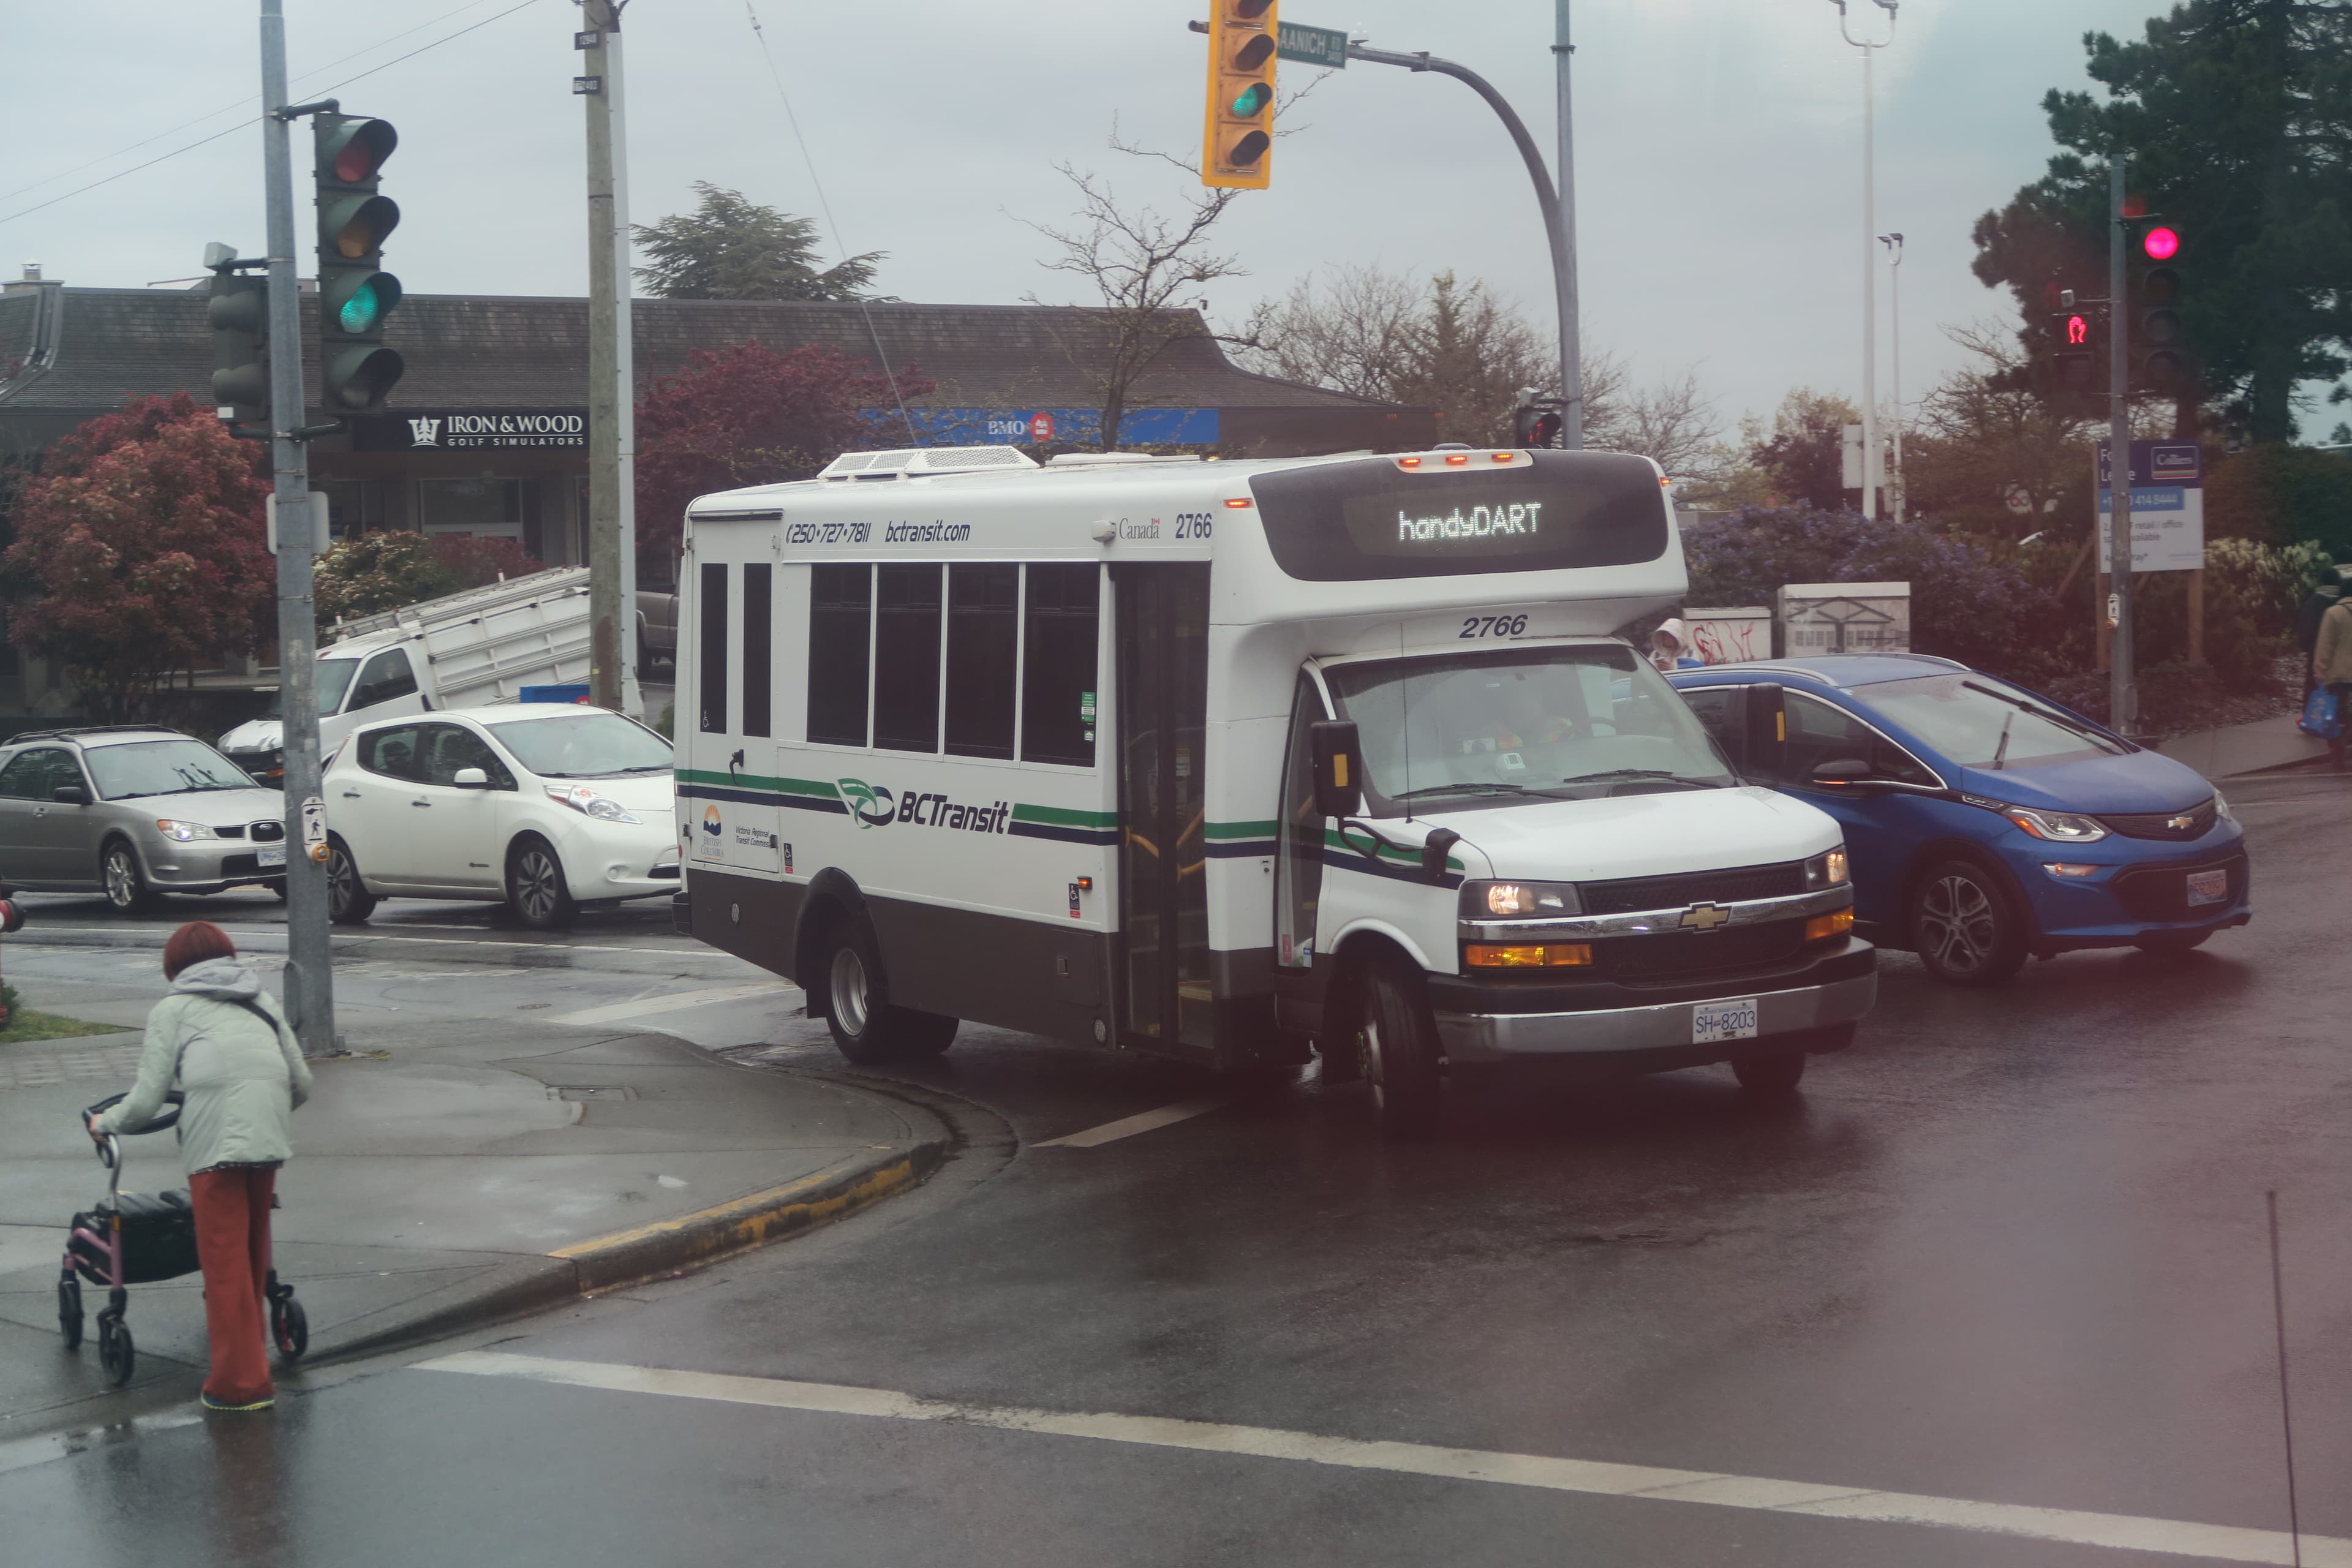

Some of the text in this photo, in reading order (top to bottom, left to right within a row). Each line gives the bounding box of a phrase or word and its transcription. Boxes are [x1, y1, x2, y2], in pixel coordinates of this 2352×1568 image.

[1278, 28, 1326, 55] AANICH
[447, 415, 582, 432] IRON & WOOD
[988, 421, 1025, 435] BMO
[447, 437, 584, 447] GOLF SIMULATORS
[2100, 469, 2136, 482] Lee
[885, 519, 971, 543] bctransit.com
[1119, 518, 1160, 539] Canada
[1175, 513, 1212, 538] 2766
[1399, 503, 1542, 540] handyDART
[1458, 614, 1528, 638] 2766
[897, 791, 1009, 834] BCTransit
[703, 835, 722, 848] BRITISH
[735, 826, 770, 839] Victoria Regional
[735, 835, 750, 845] Transit
